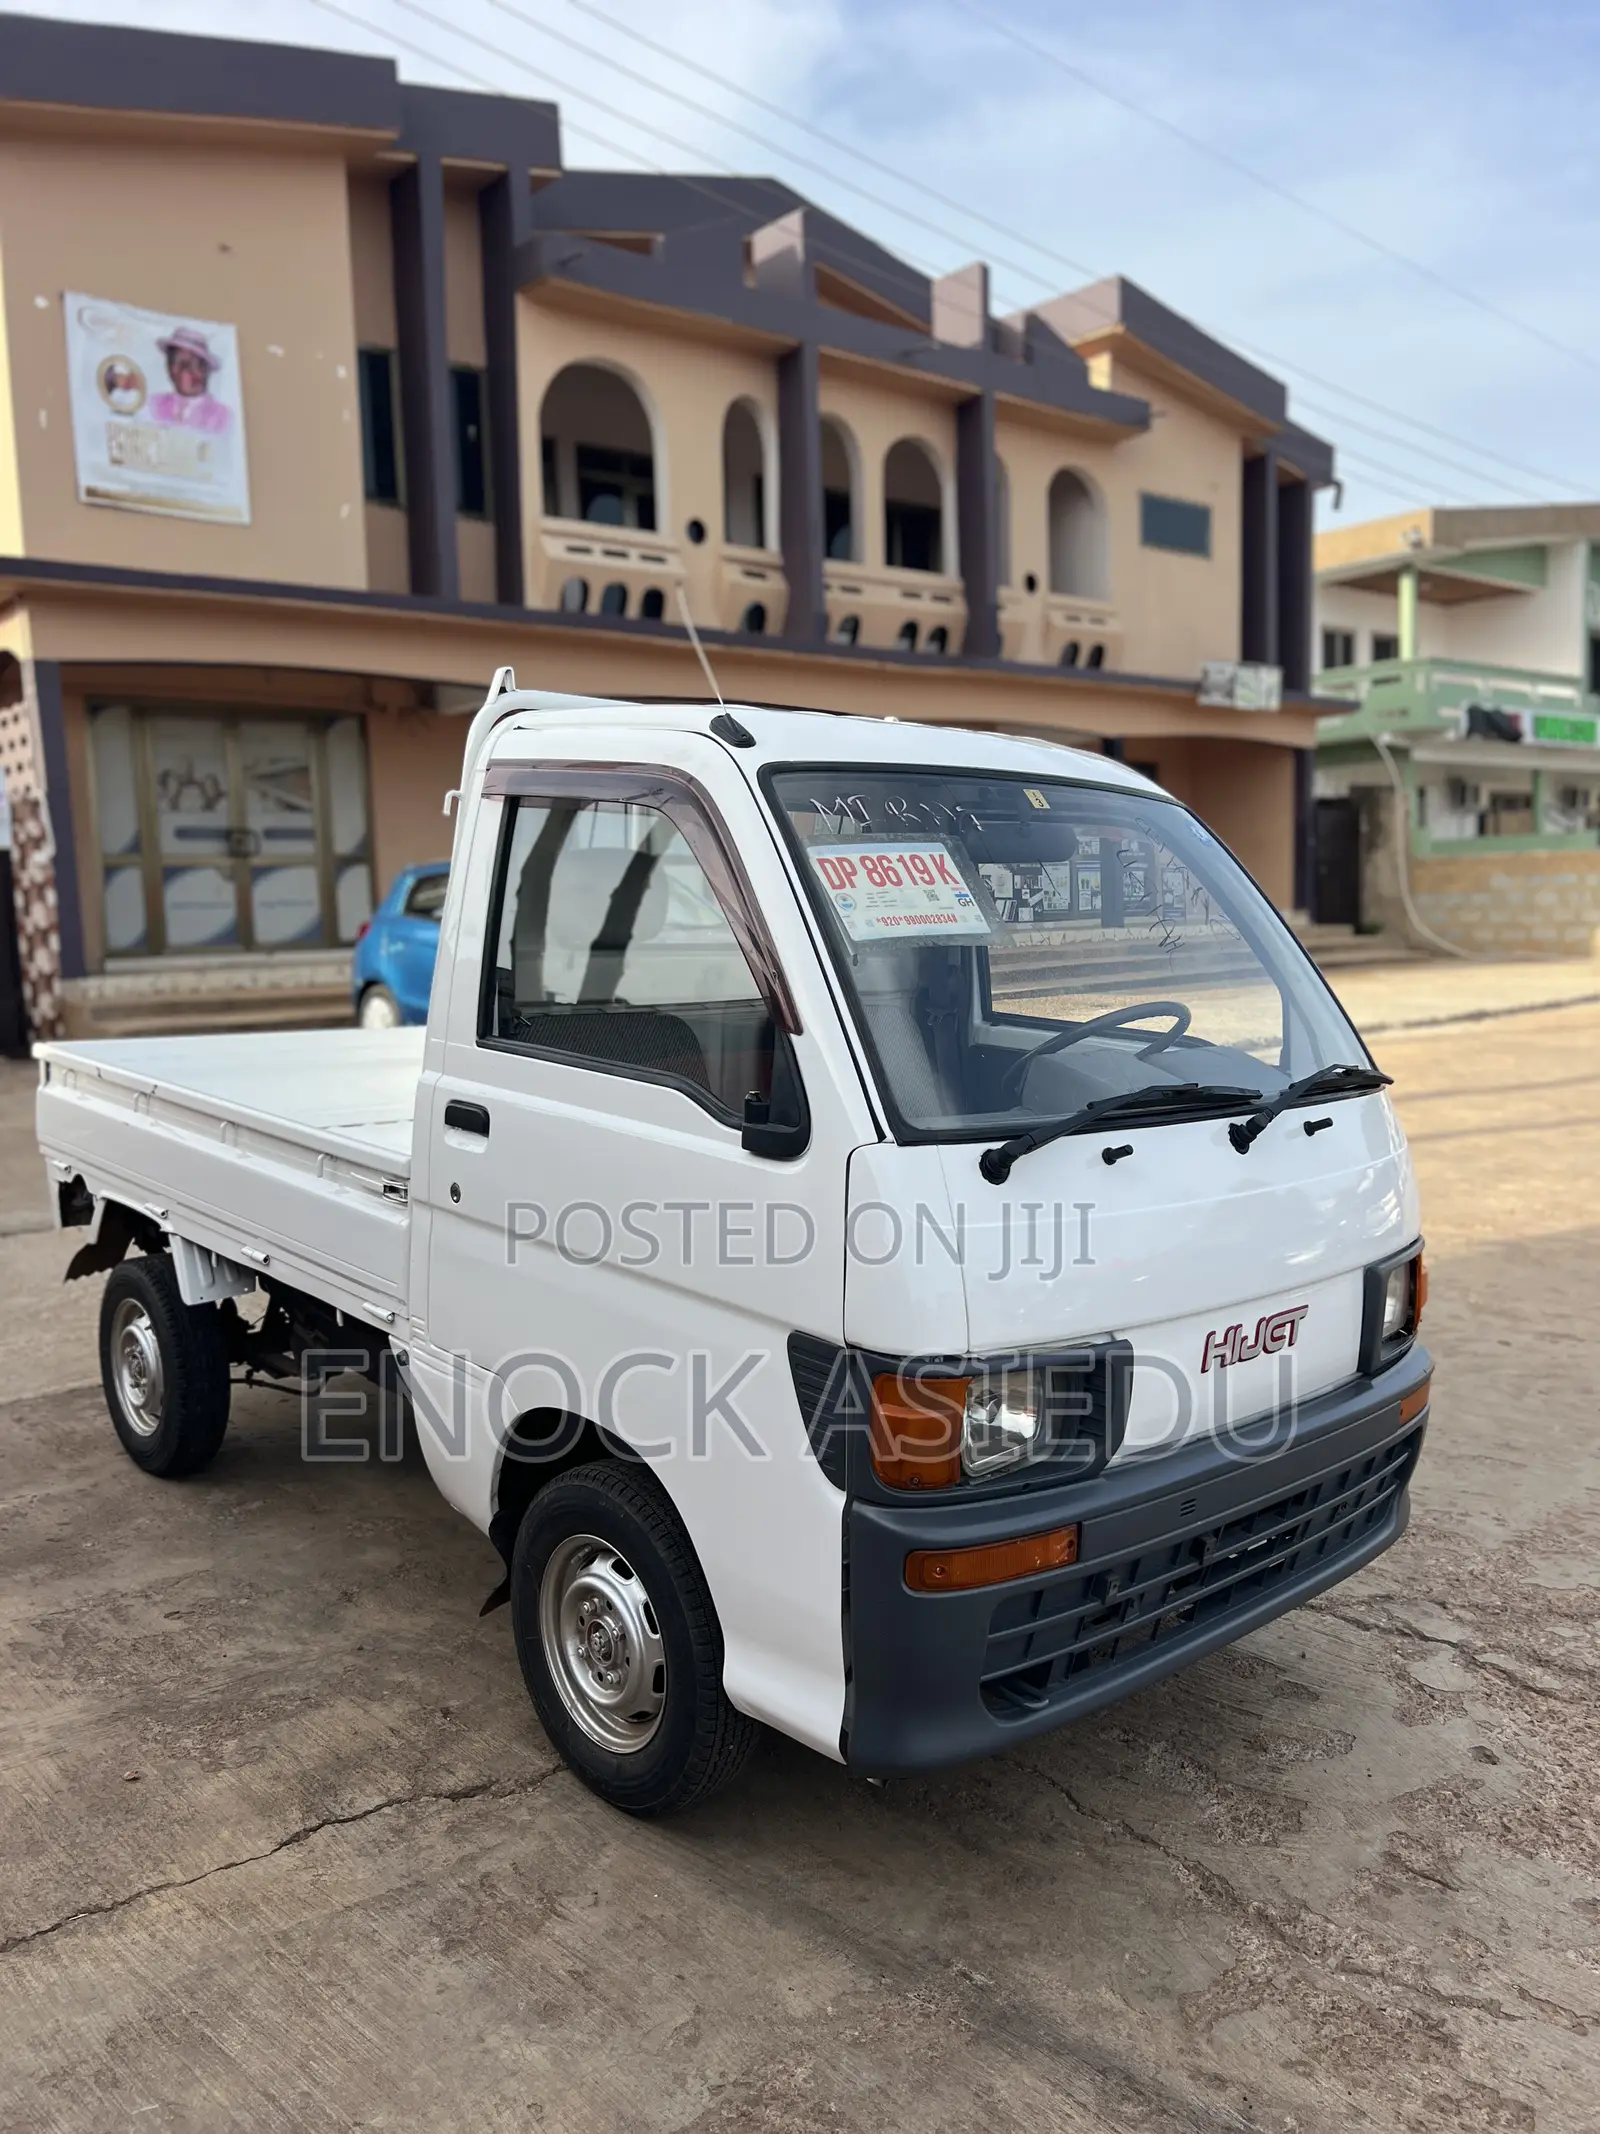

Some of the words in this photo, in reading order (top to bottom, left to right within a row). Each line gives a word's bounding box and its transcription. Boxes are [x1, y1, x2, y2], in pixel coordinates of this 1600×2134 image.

[816, 856, 858, 890] DP
[859, 854, 936, 887] 8619
[929, 854, 960, 885] K
[957, 898, 975, 907] GH
[1200, 1304, 1309, 1373] HIJET
